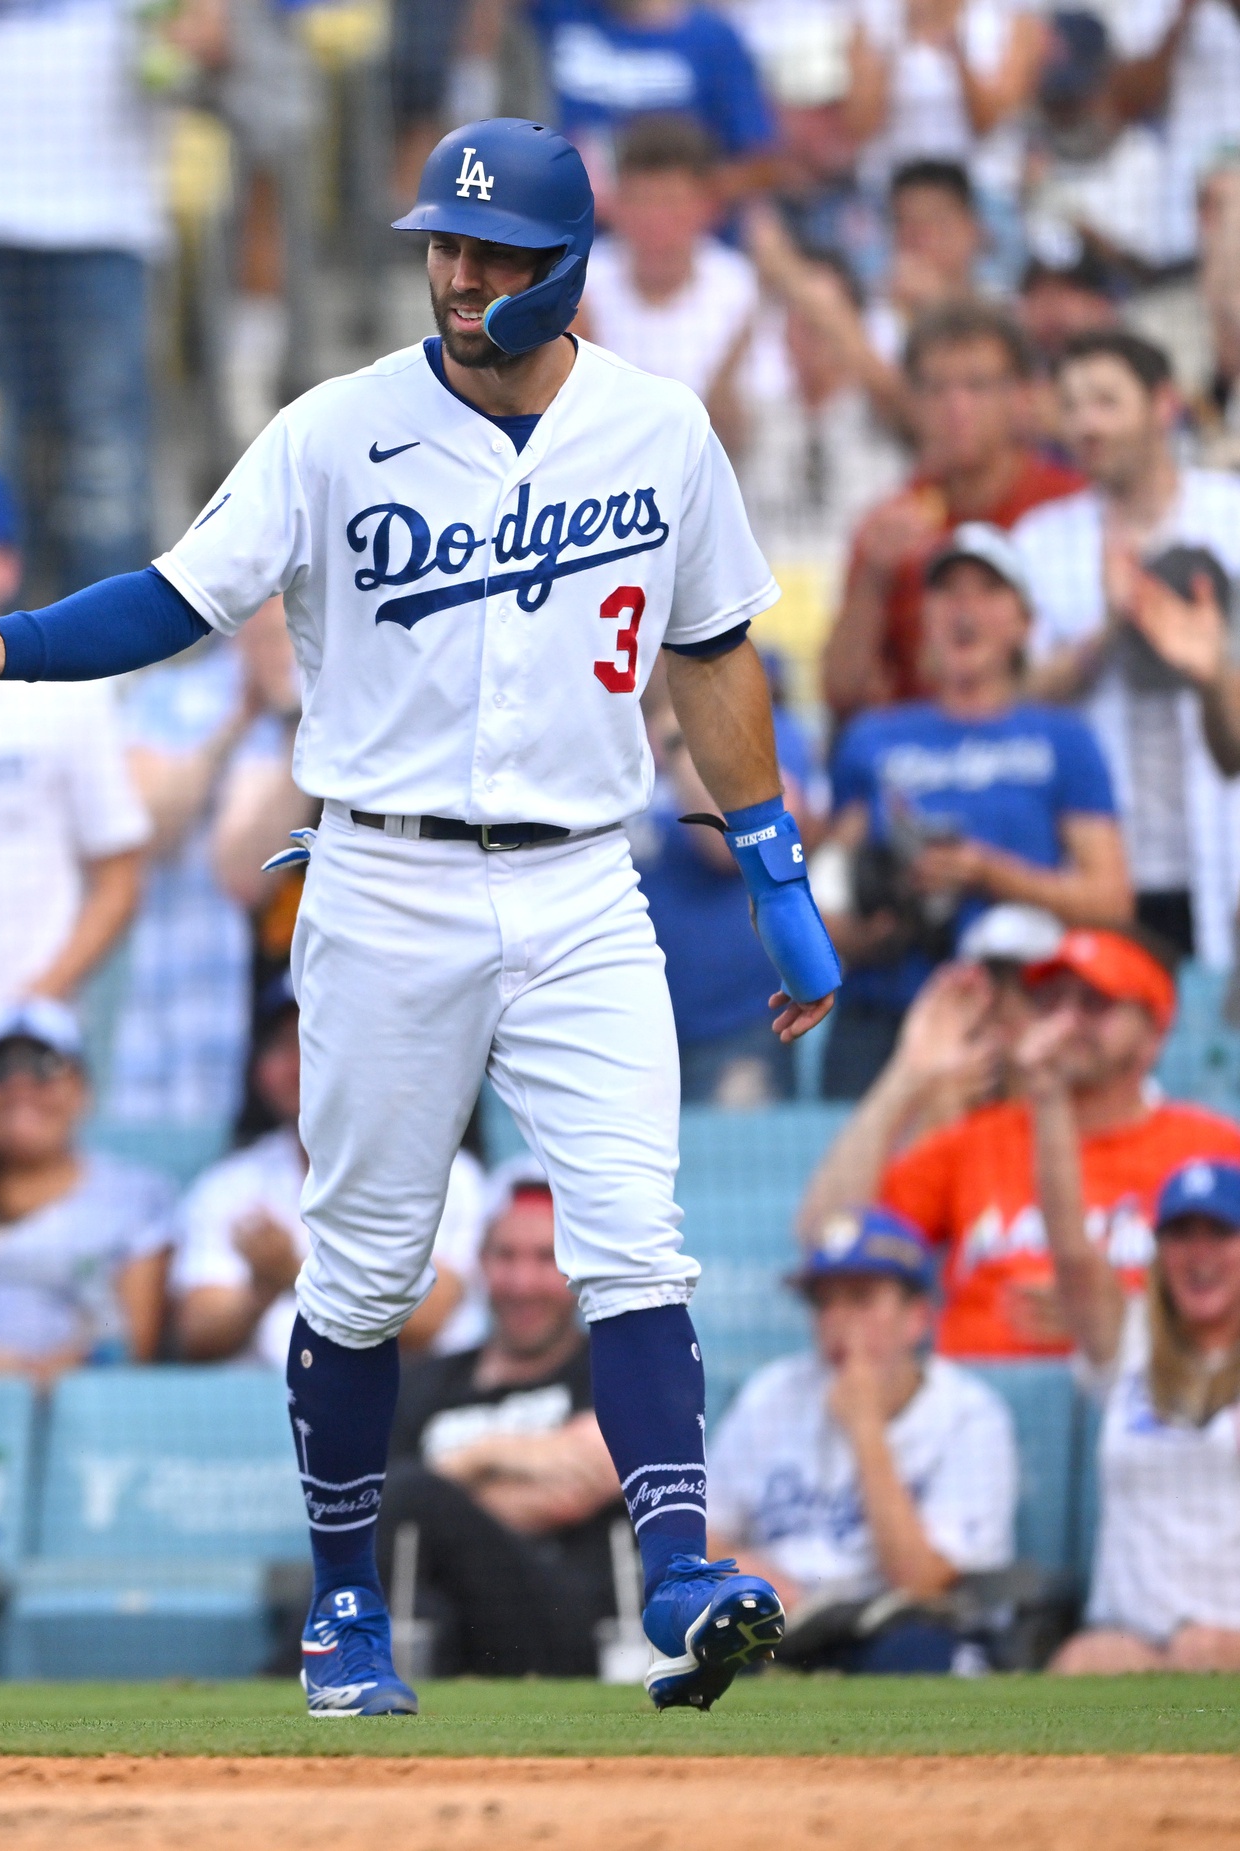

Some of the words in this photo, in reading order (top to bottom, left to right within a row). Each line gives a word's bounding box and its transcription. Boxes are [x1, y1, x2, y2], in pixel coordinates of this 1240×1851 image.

[456, 147, 494, 201] LA
[347, 483, 669, 613] Dodgers
[593, 586, 646, 693] 3
[791, 843, 804, 864] 3
[632, 1478, 695, 1511] Angeles
